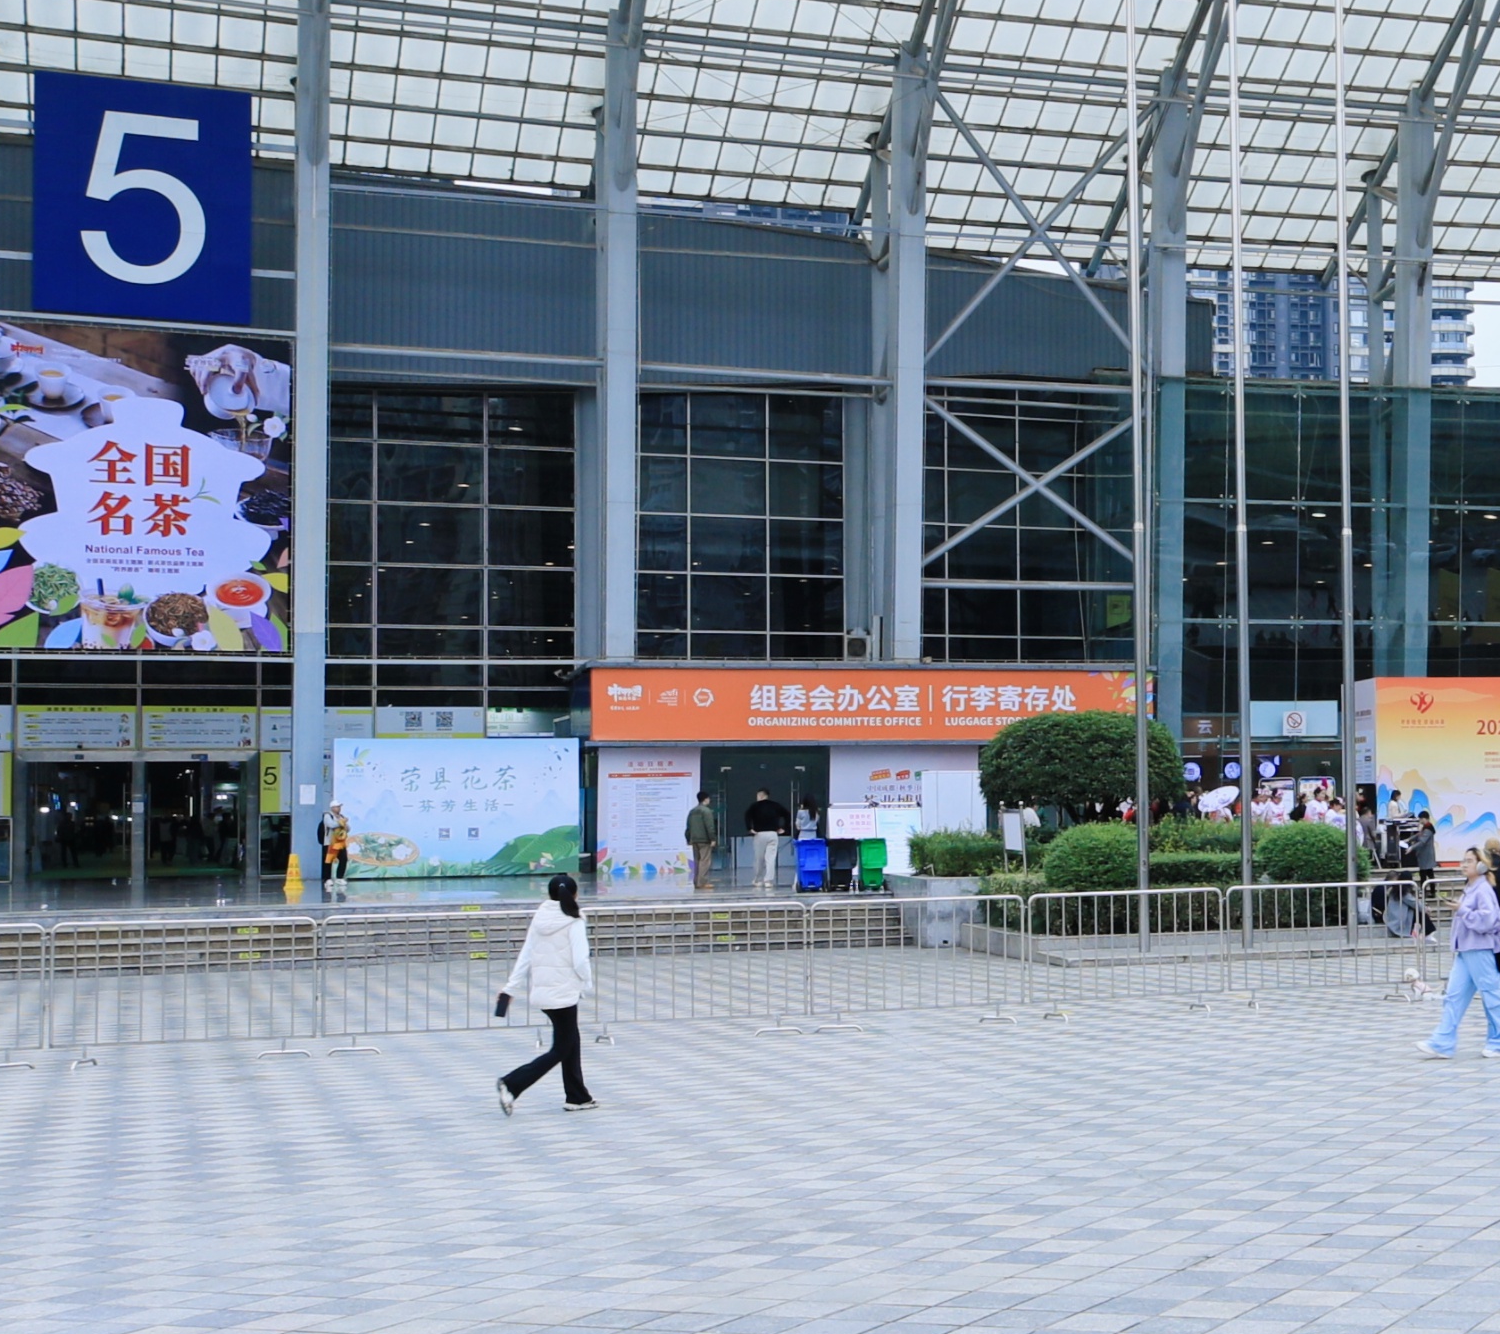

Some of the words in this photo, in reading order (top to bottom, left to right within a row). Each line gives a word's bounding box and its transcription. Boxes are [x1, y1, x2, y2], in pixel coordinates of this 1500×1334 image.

[80, 110, 206, 285] 5
[87, 440, 191, 487] 全国
[87, 491, 192, 537] 名茶
[85, 545, 133, 555] National
[136, 546, 182, 556] Famous
[185, 547, 205, 557] Tea
[750, 684, 920, 711] 组委会办公室
[942, 685, 1076, 711] 行李寄存处
[748, 716, 817, 726] ORGANIZING
[819, 716, 882, 726] COMMITTEE
[884, 716, 922, 726] OFFICE
[945, 716, 993, 726] LUGGAGE
[263, 767, 277, 785] 5
[400, 765, 517, 792] 荣县花茶
[418, 798, 500, 813] 芬芳生活
